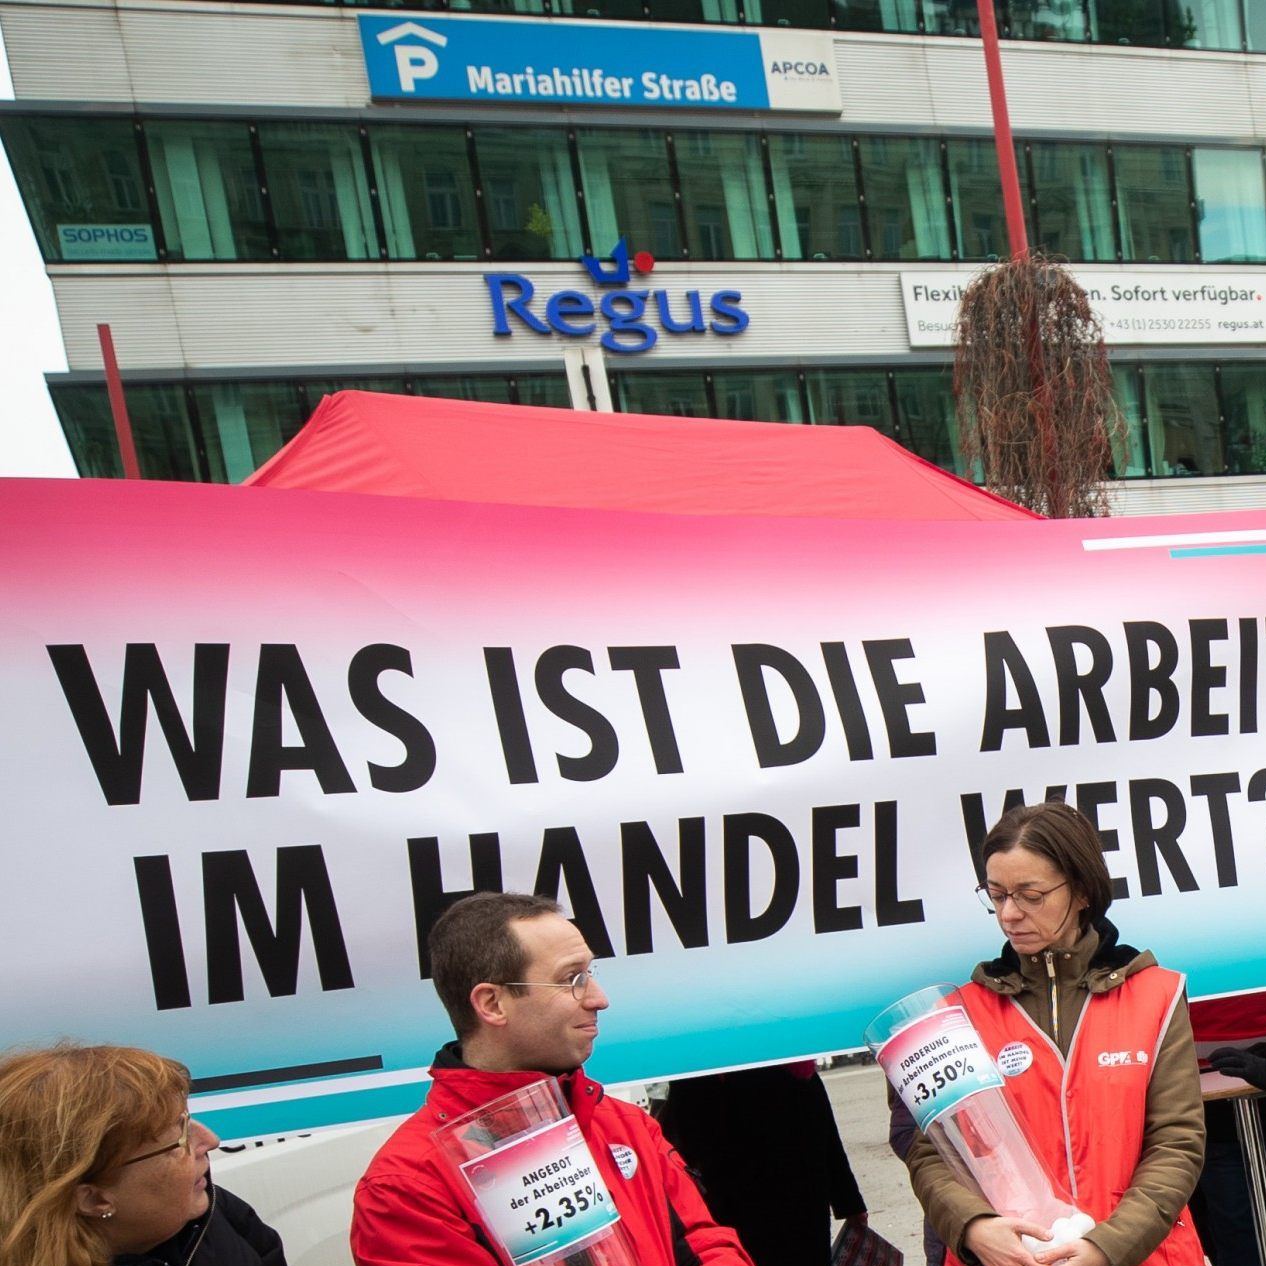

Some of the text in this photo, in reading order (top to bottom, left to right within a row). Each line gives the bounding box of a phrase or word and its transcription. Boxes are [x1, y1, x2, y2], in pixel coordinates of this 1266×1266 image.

[394, 45, 439, 92] P
[466, 65, 736, 102] Mariahilfer Straße
[771, 61, 830, 75] APCOA
[62, 228, 148, 243] SOPHOS
[483, 272, 751, 353] Regus
[1111, 284, 1168, 301] Sofort
[1172, 284, 1263, 306] verfügbar.
[1217, 319, 1264, 332] regus.at
[45, 642, 436, 806] WAS
[483, 644, 684, 785] IST
[731, 637, 937, 769] DIE
[134, 844, 355, 1011] IM
[407, 800, 925, 980] HANDEL
[900, 1036, 950, 1071] FORDERUNG
[914, 1057, 975, 1106] +3,50%
[510, 1166, 591, 1210] der Arbeitgeber
[522, 1156, 573, 1187] ANGEBOT
[525, 1182, 604, 1235] +2,35%
